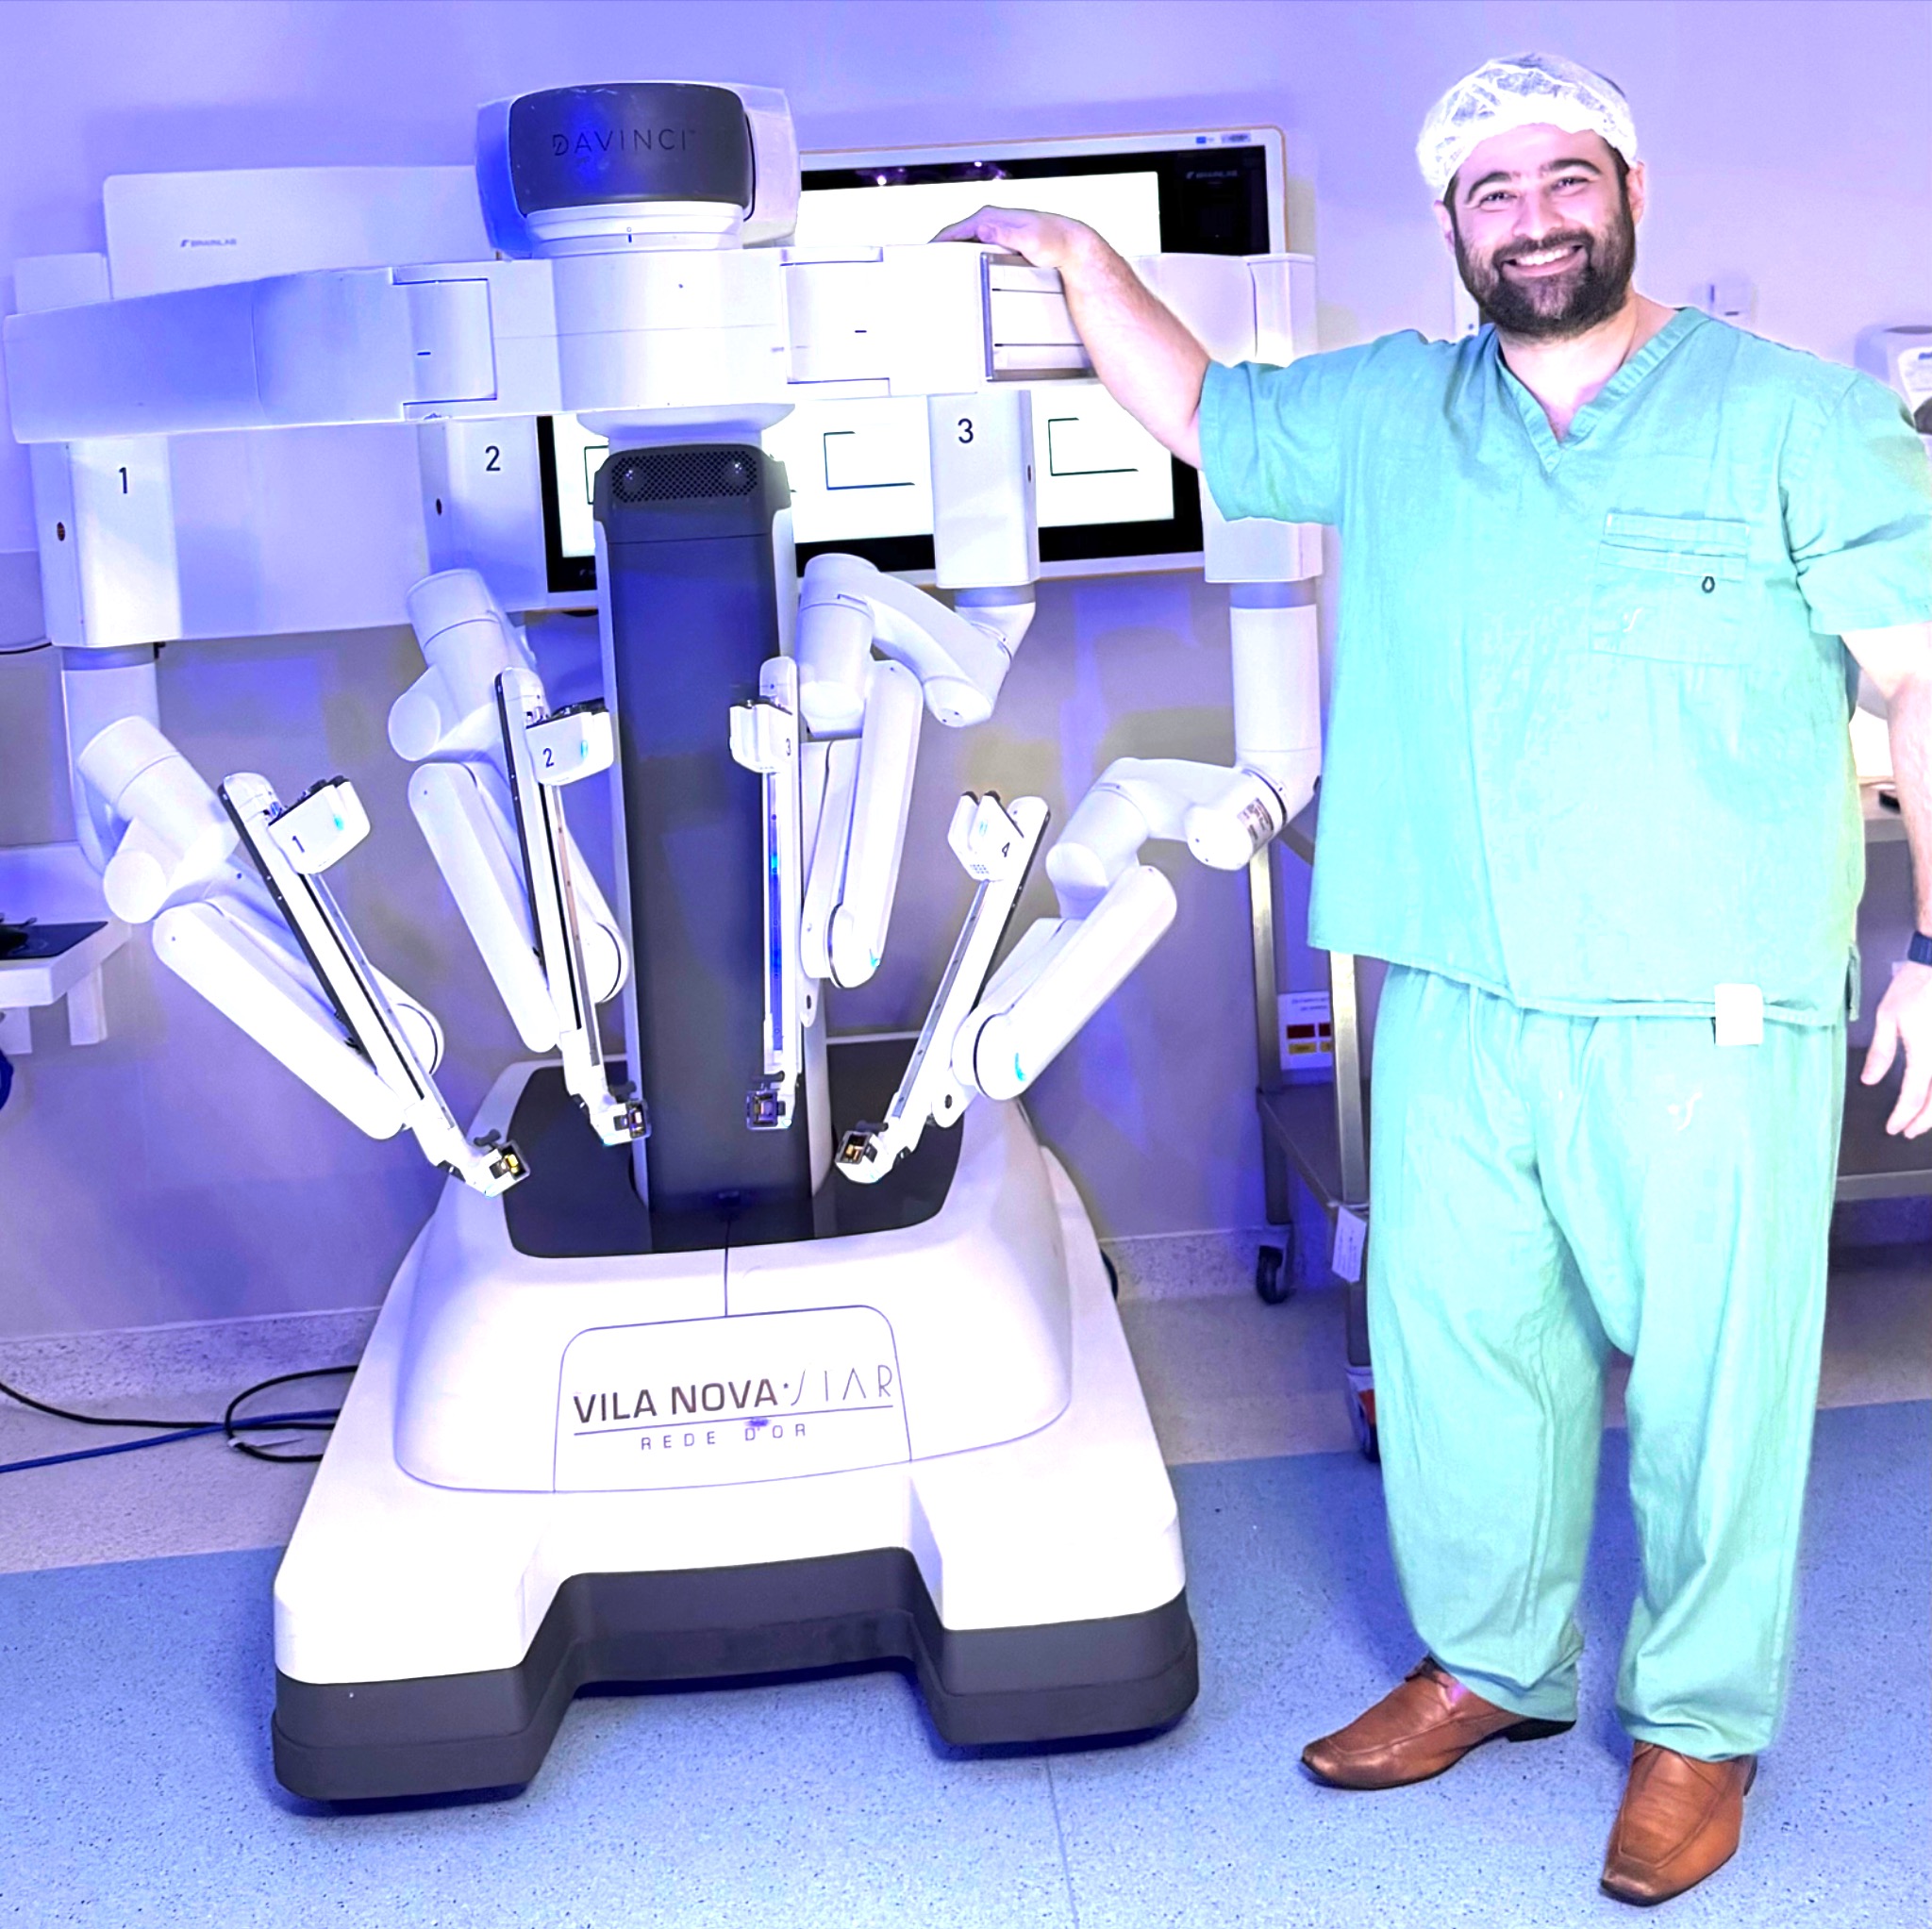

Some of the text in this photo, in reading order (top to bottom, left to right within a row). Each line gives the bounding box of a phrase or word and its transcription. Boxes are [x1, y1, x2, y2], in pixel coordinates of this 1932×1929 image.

[958, 418, 974, 443] 3
[485, 445, 501, 472] 2
[119, 467, 128, 494] 1
[542, 747, 555, 768] 2
[292, 835, 306, 853] 1
[1001, 841, 1010, 857] 4
[574, 1389, 658, 1423] VILA
[672, 1378, 778, 1416] NOVA
[641, 1431, 716, 1451] REDE
